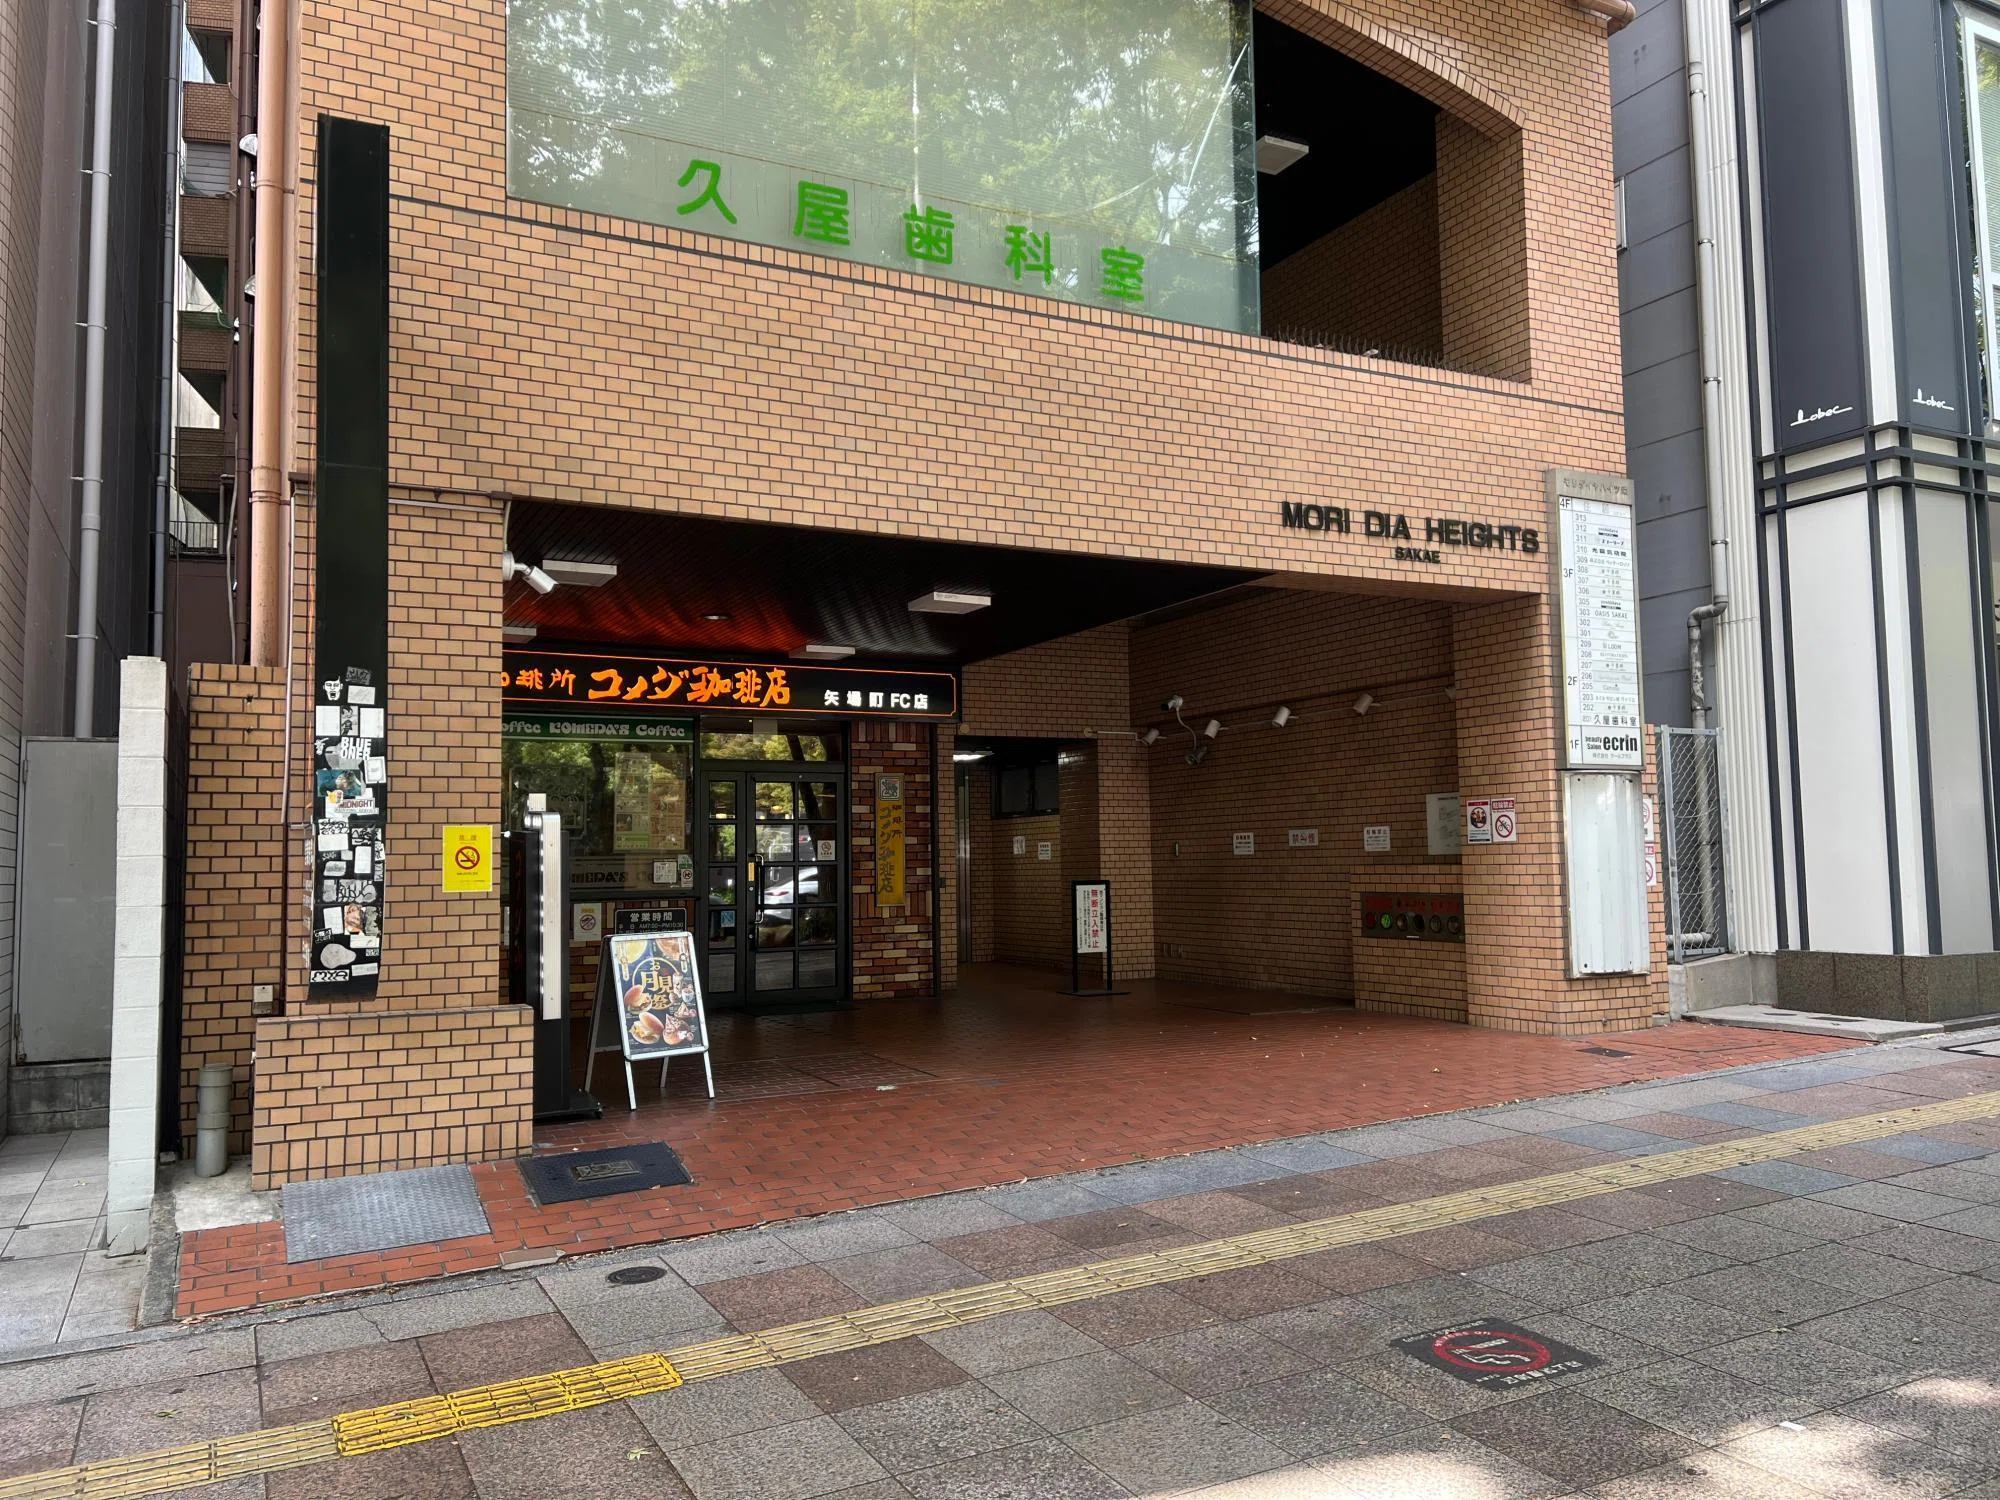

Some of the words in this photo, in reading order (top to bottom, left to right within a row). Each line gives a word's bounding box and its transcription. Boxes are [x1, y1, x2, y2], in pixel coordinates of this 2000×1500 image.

[677, 159, 1146, 301] 久屋歯科室
[1560, 498, 1570, 508] 4F
[1576, 513, 1587, 522] 313
[1282, 501, 1350, 534] MORI
[1364, 510, 1411, 540] DIA
[1426, 517, 1540, 553] HEIGHTS
[1576, 523, 1587, 532] 312
[1576, 544, 1588, 553] 310
[1395, 546, 1441, 564] SAKAE
[1577, 555, 1588, 564] 309
[1563, 568, 1574, 578] 3F
[1577, 576, 1589, 585] 307
[1578, 587, 1590, 595] 306
[1578, 597, 1590, 606] 305
[1579, 608, 1590, 616] 303
[1579, 618, 1591, 627] 302
[1580, 628, 1591, 637] 301
[1580, 639, 1592, 648] 209
[1581, 661, 1593, 669] 207
[1581, 672, 1593, 680] 206
[1567, 676, 1578, 686] 2F
[588, 665, 791, 708] コメダ珈琲店
[824, 689, 929, 710] 矢場町FC店
[1582, 682, 1594, 690] 205
[1582, 693, 1594, 701] 203
[1583, 703, 1594, 712] 202
[1594, 715, 1637, 726] 久屋歯科室
[501, 720, 542, 734] offee
[550, 722, 630, 736] KOMEDA'S
[635, 725, 686, 738] Coffee
[341, 736, 372, 749] BLUE
[1570, 739, 1580, 750] 1F
[1603, 733, 1638, 751] ecrin
[630, 911, 673, 923] 営業時間
